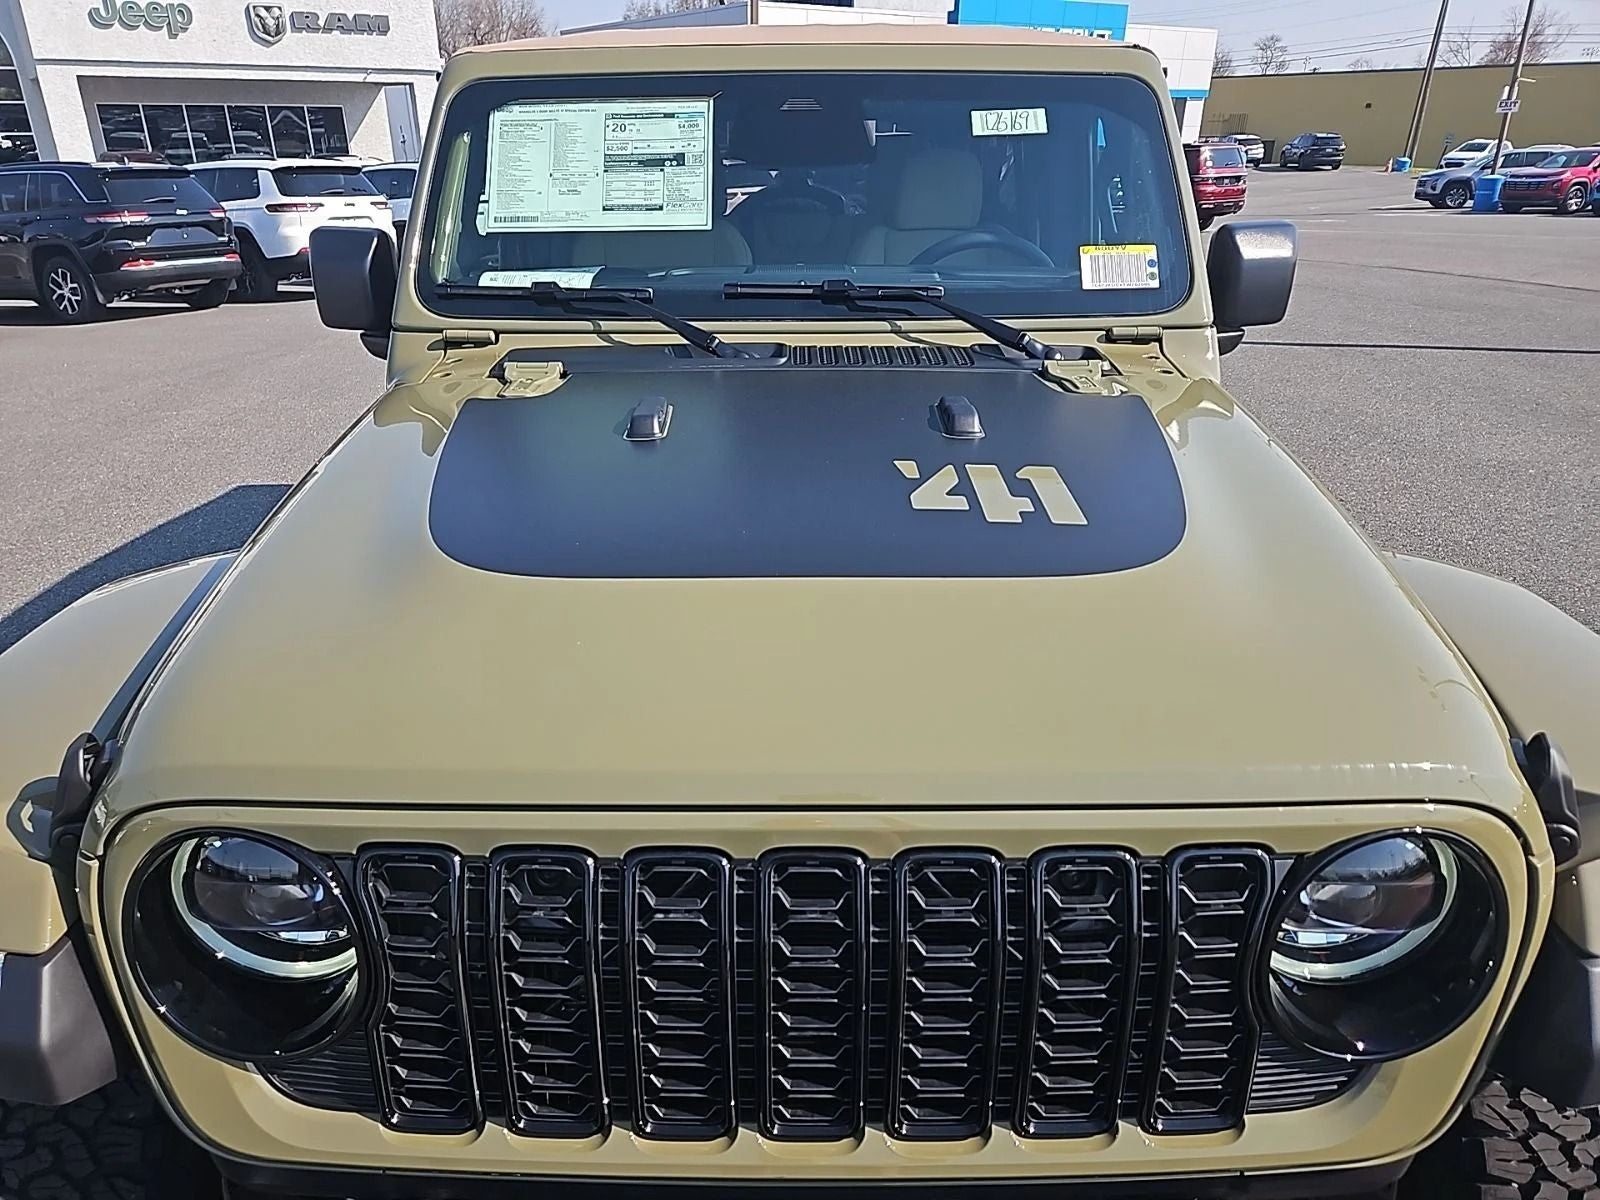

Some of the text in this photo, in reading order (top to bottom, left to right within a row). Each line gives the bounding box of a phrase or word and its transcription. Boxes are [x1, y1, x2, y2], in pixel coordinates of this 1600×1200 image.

[88, 0, 193, 39] Jeep
[290, 11, 390, 36] RAM
[611, 123, 627, 133] 20
